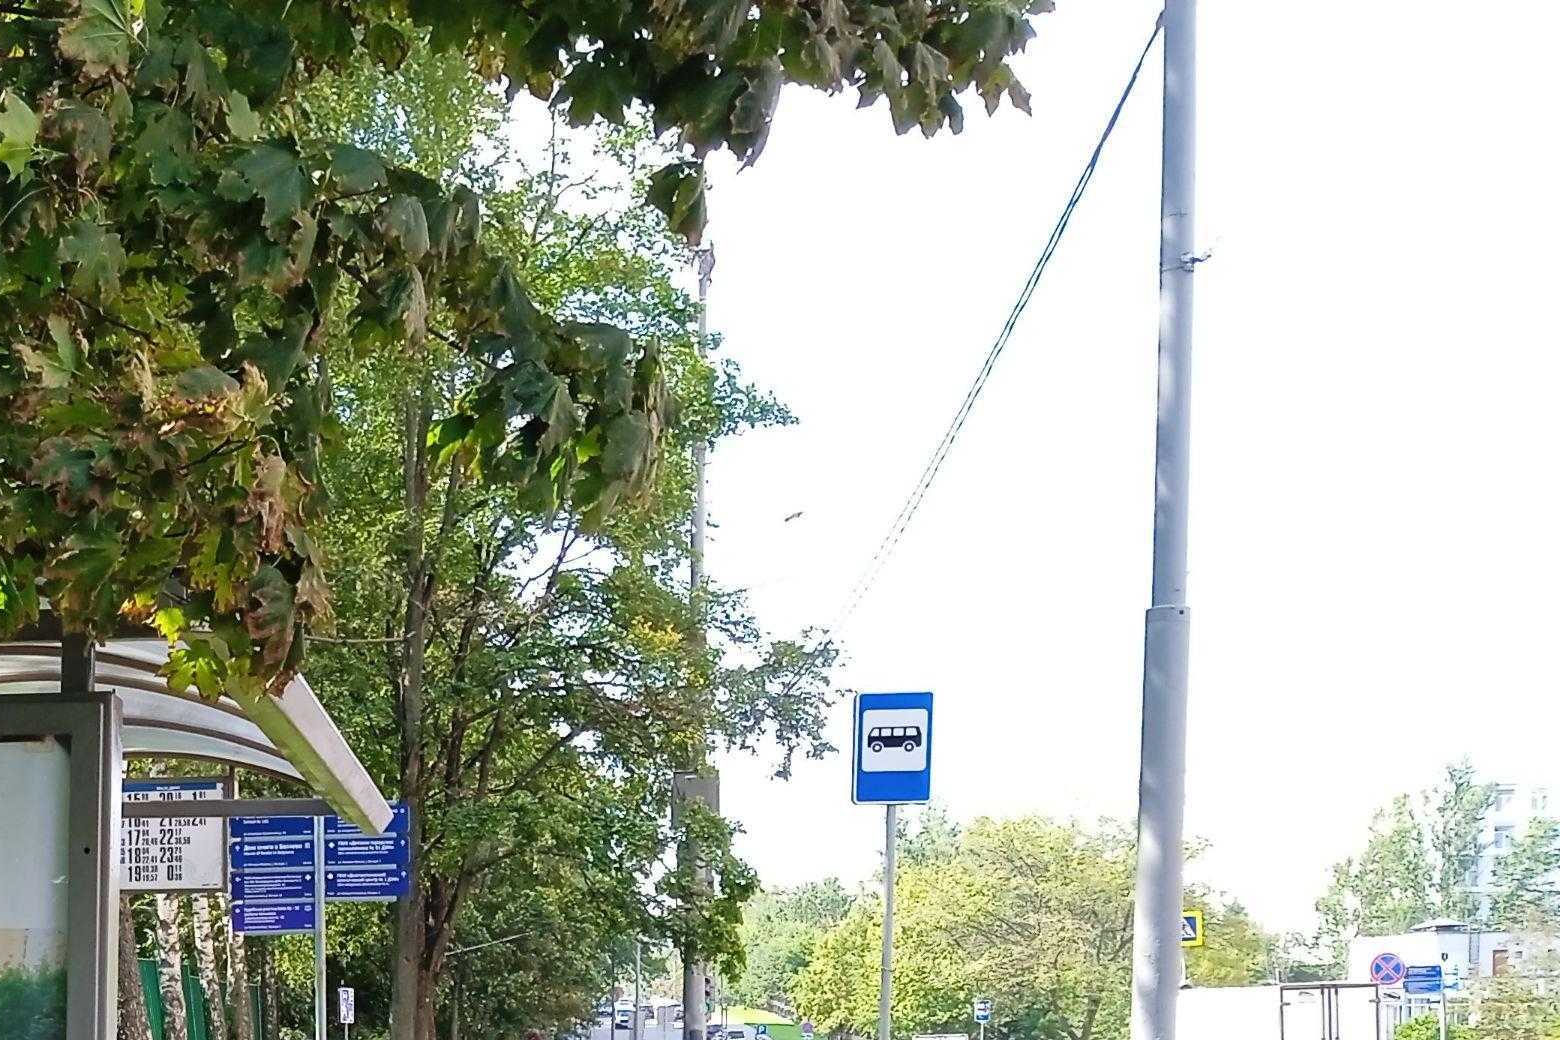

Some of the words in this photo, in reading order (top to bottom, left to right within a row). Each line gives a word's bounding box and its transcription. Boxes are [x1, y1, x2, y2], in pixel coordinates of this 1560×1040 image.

[127, 829, 140, 847] 17
[159, 828, 174, 846] 22
[127, 847, 141, 864] 18
[159, 846, 174, 863] 23
[127, 865, 141, 882] 19
